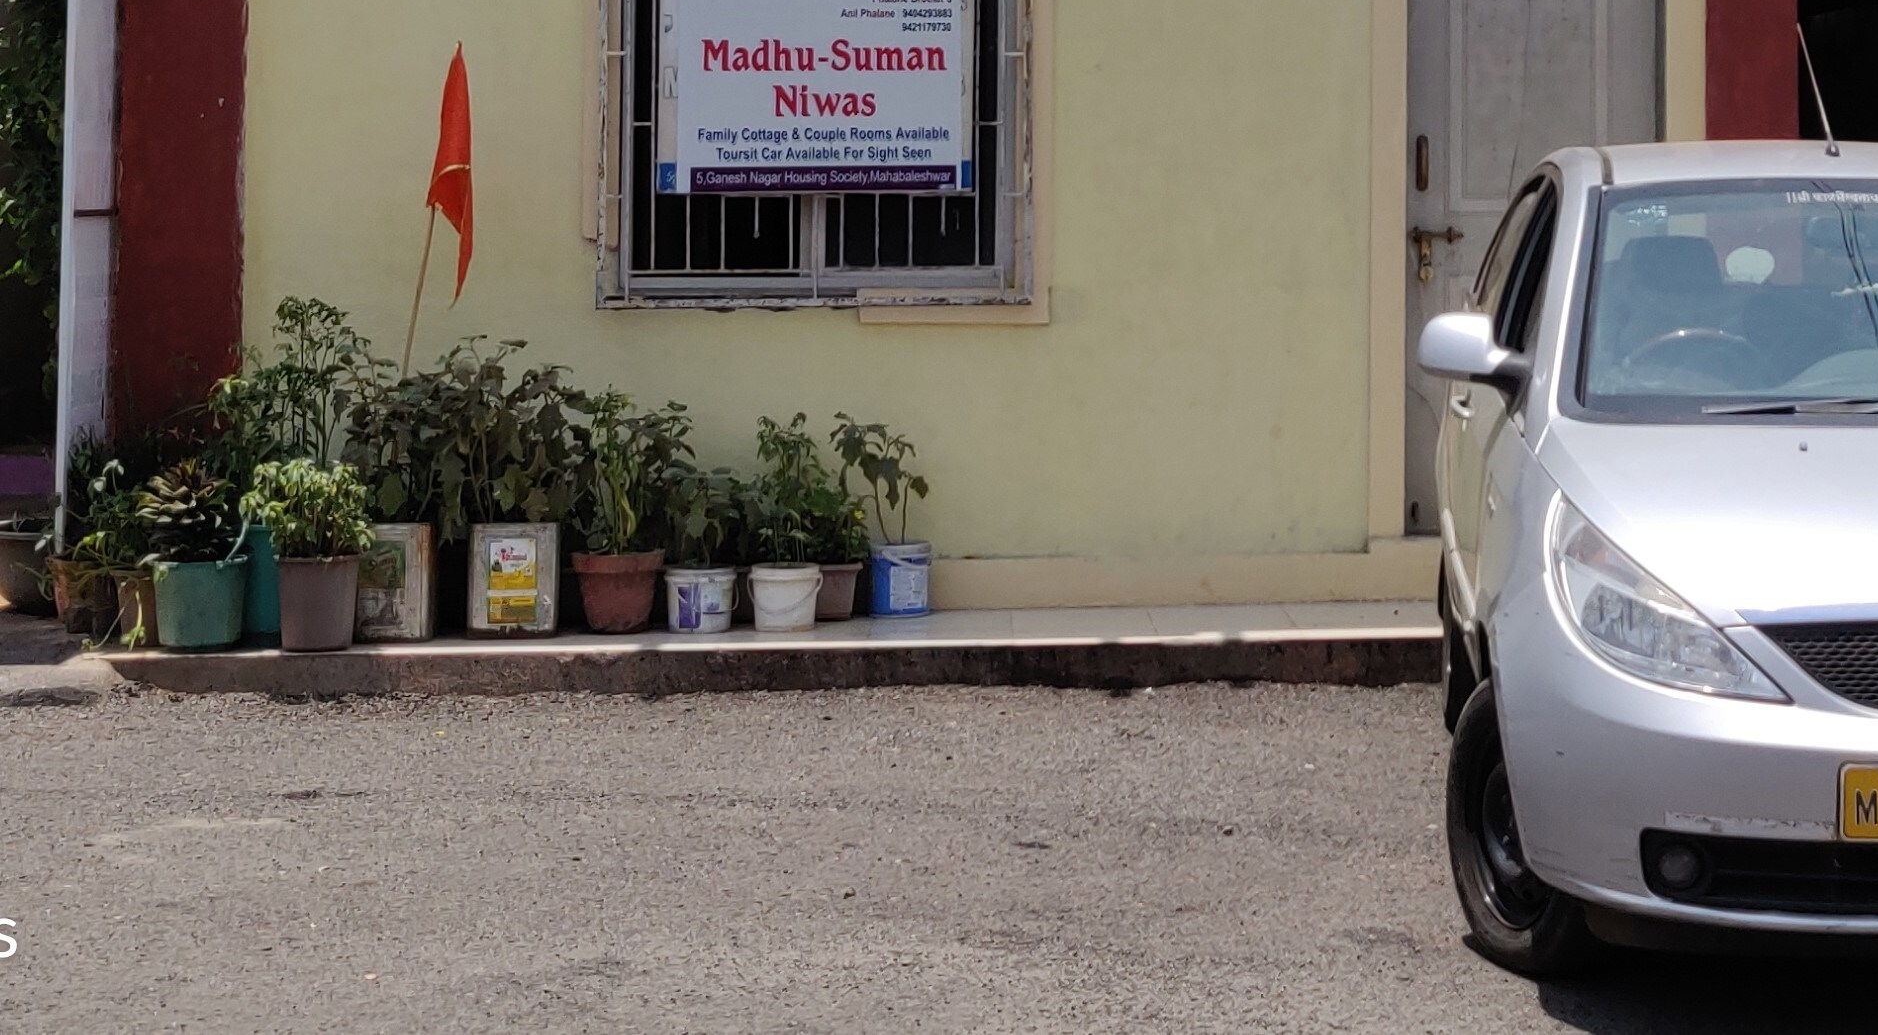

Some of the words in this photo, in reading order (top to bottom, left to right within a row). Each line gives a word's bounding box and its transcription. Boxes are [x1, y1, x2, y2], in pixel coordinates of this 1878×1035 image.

[861, 8, 896, 18] Phalane
[701, 38, 948, 72] Madhu-Suman
[773, 84, 877, 118] Niwas
[698, 127, 738, 144] Family
[741, 127, 788, 144] Cottage
[791, 127, 800, 140] &
[804, 127, 846, 143] Couple
[850, 127, 892, 140] Rooms
[896, 127, 950, 140] Available
[716, 147, 758, 160] Toursit
[761, 147, 782, 160] Car
[785, 146, 840, 160] Available
[844, 146, 864, 159] For
[867, 146, 898, 162] Sight
[902, 146, 932, 158] Seen
[696, 171, 747, 185] 5,Ganesh
[750, 170, 782, 186] Nagar
[784, 170, 828, 186] Housing
